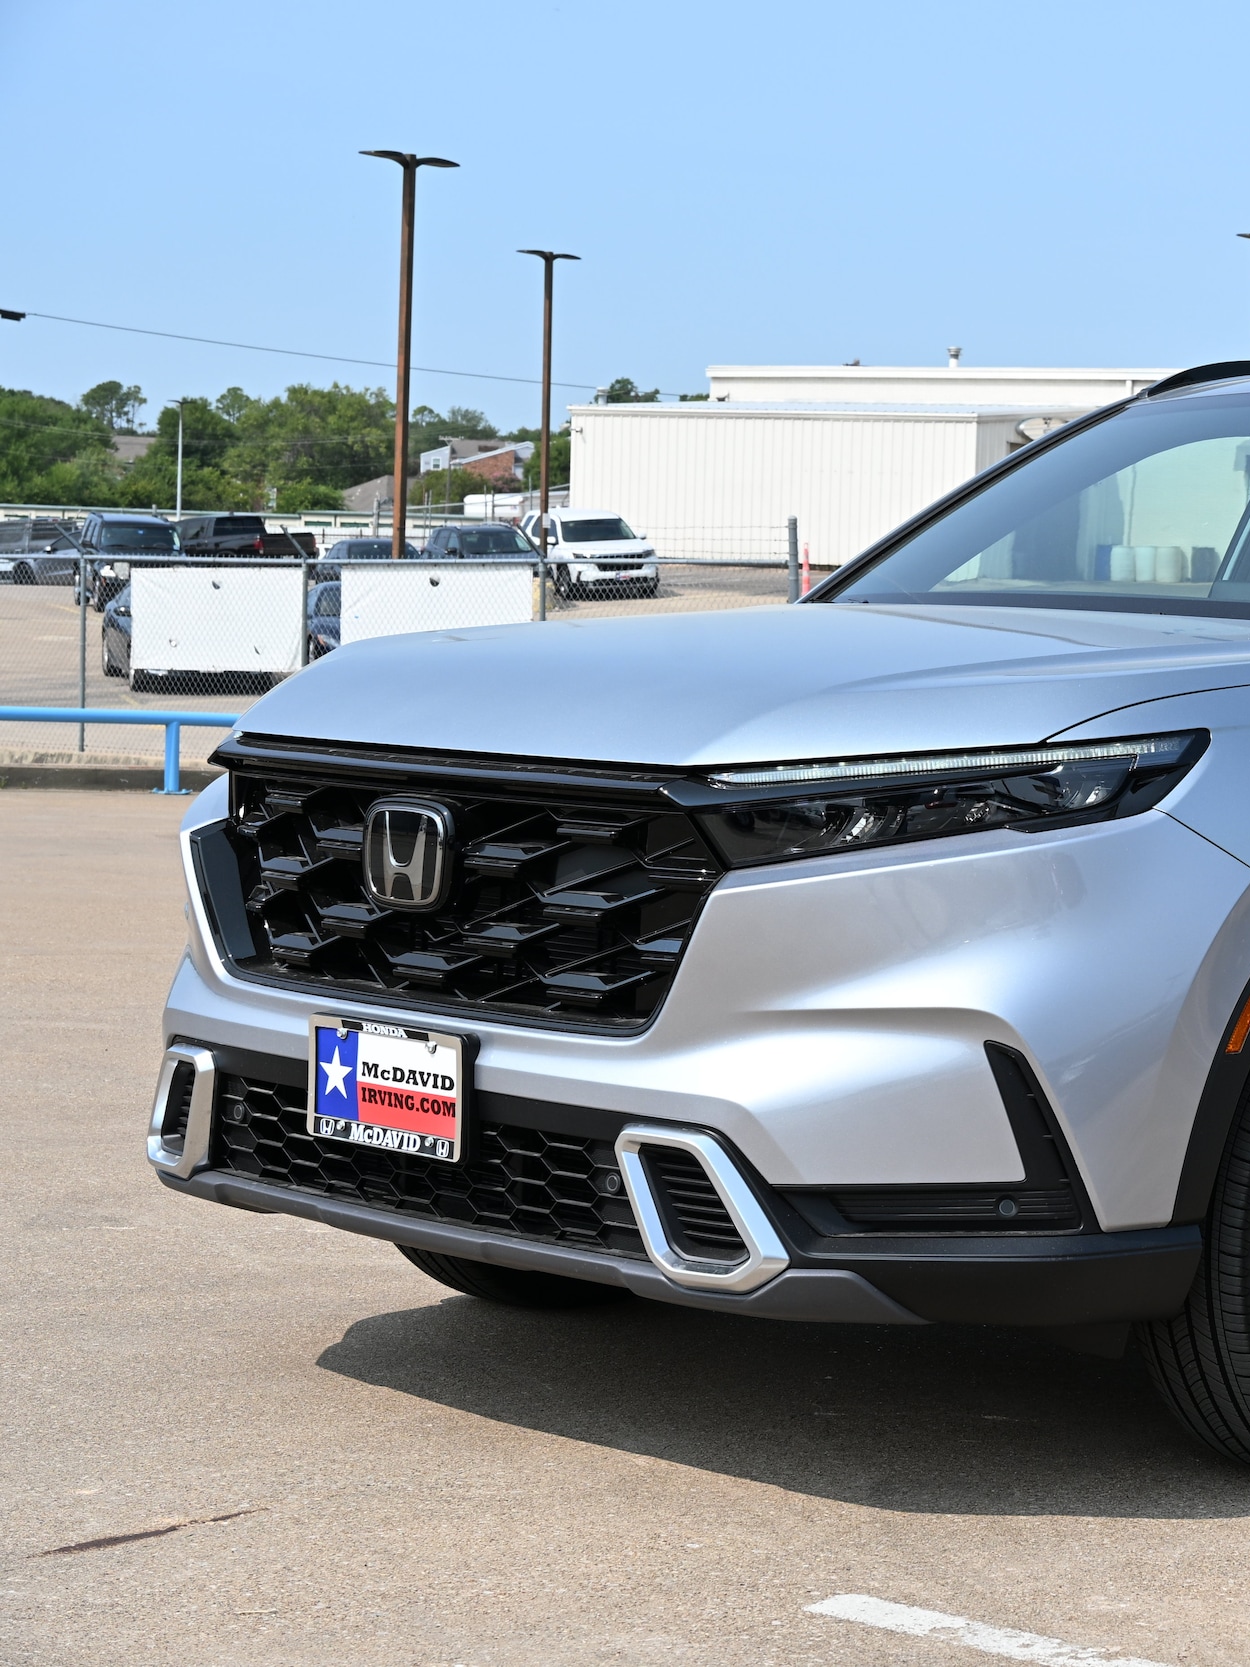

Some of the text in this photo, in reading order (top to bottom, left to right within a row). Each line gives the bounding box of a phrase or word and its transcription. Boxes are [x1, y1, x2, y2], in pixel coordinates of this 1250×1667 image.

[362, 1022, 408, 1039] HONDA
[361, 1061, 455, 1091] McDAVID
[361, 1087, 456, 1118] IRVING.COM
[349, 1122, 421, 1152] McDAVID
